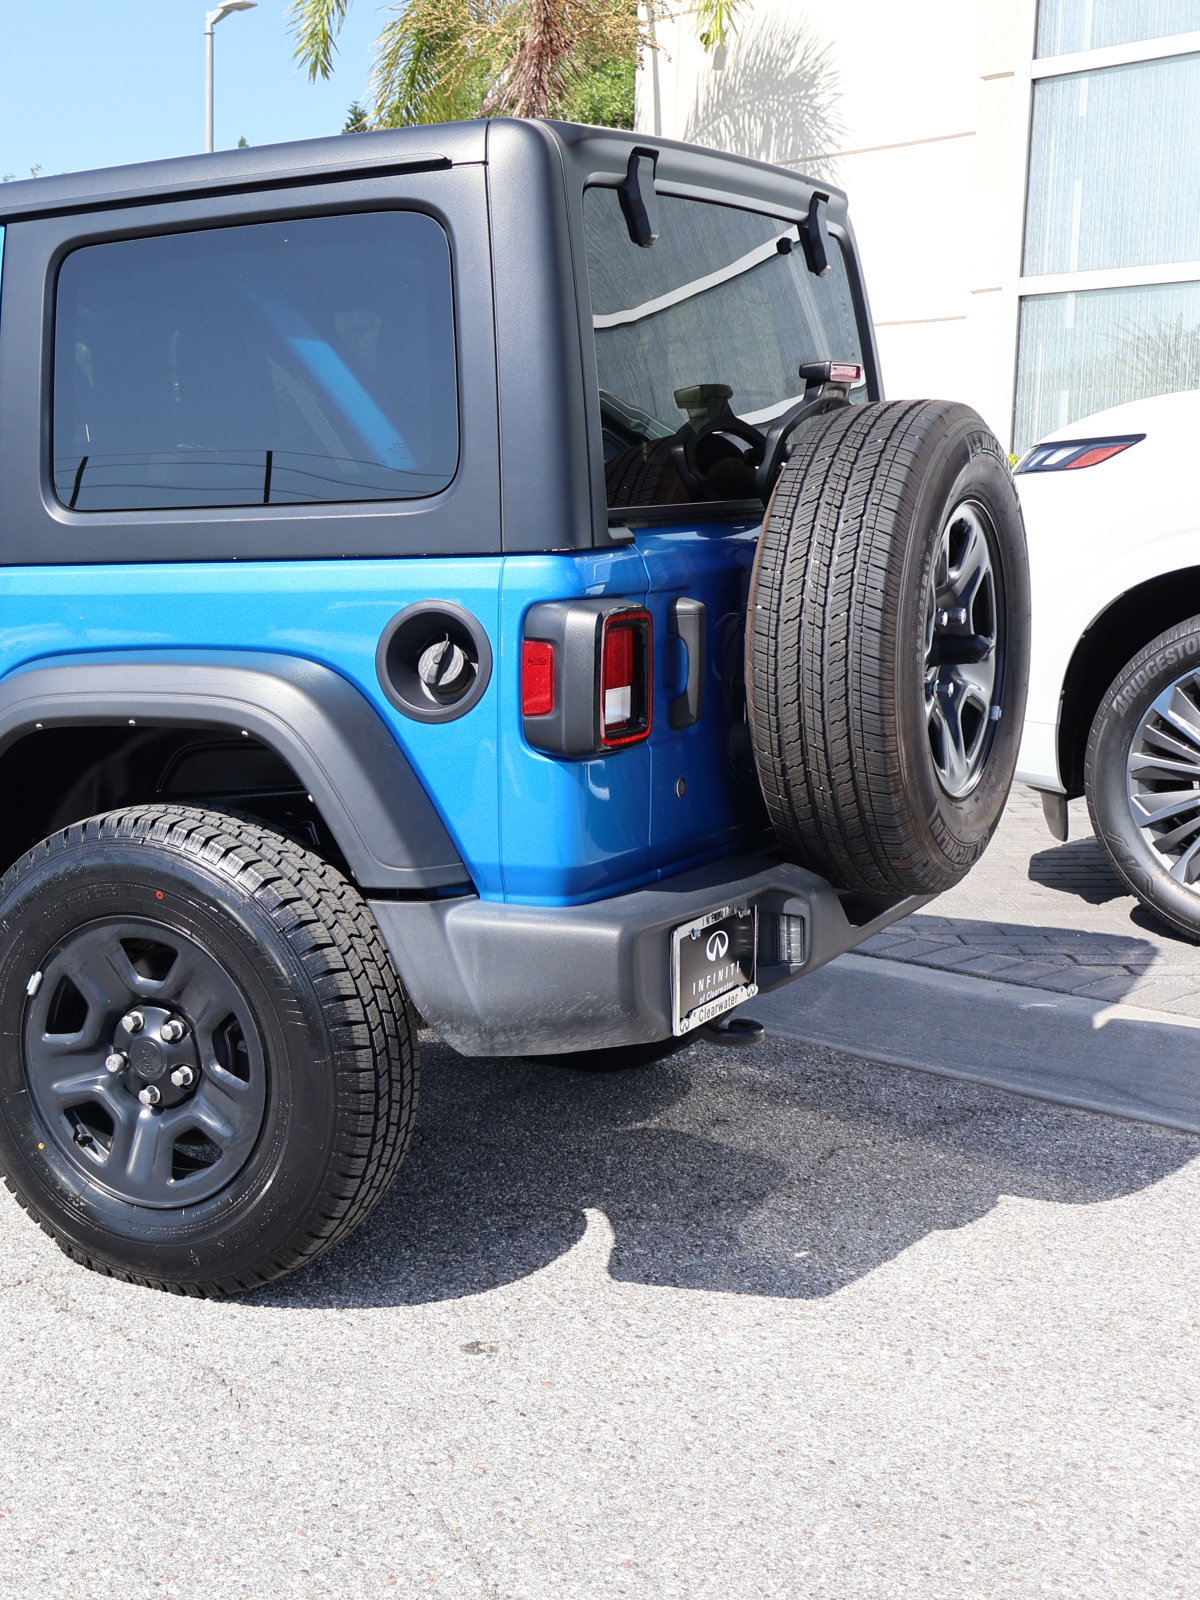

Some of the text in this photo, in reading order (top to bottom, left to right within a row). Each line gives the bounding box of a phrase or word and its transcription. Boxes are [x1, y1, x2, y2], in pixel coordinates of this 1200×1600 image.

[1112, 635, 1200, 718] BRIDGESTO
[692, 961, 741, 995] INFINITI
[698, 981, 735, 1005] of Clearwater
[698, 993, 739, 1022] Clearwater
